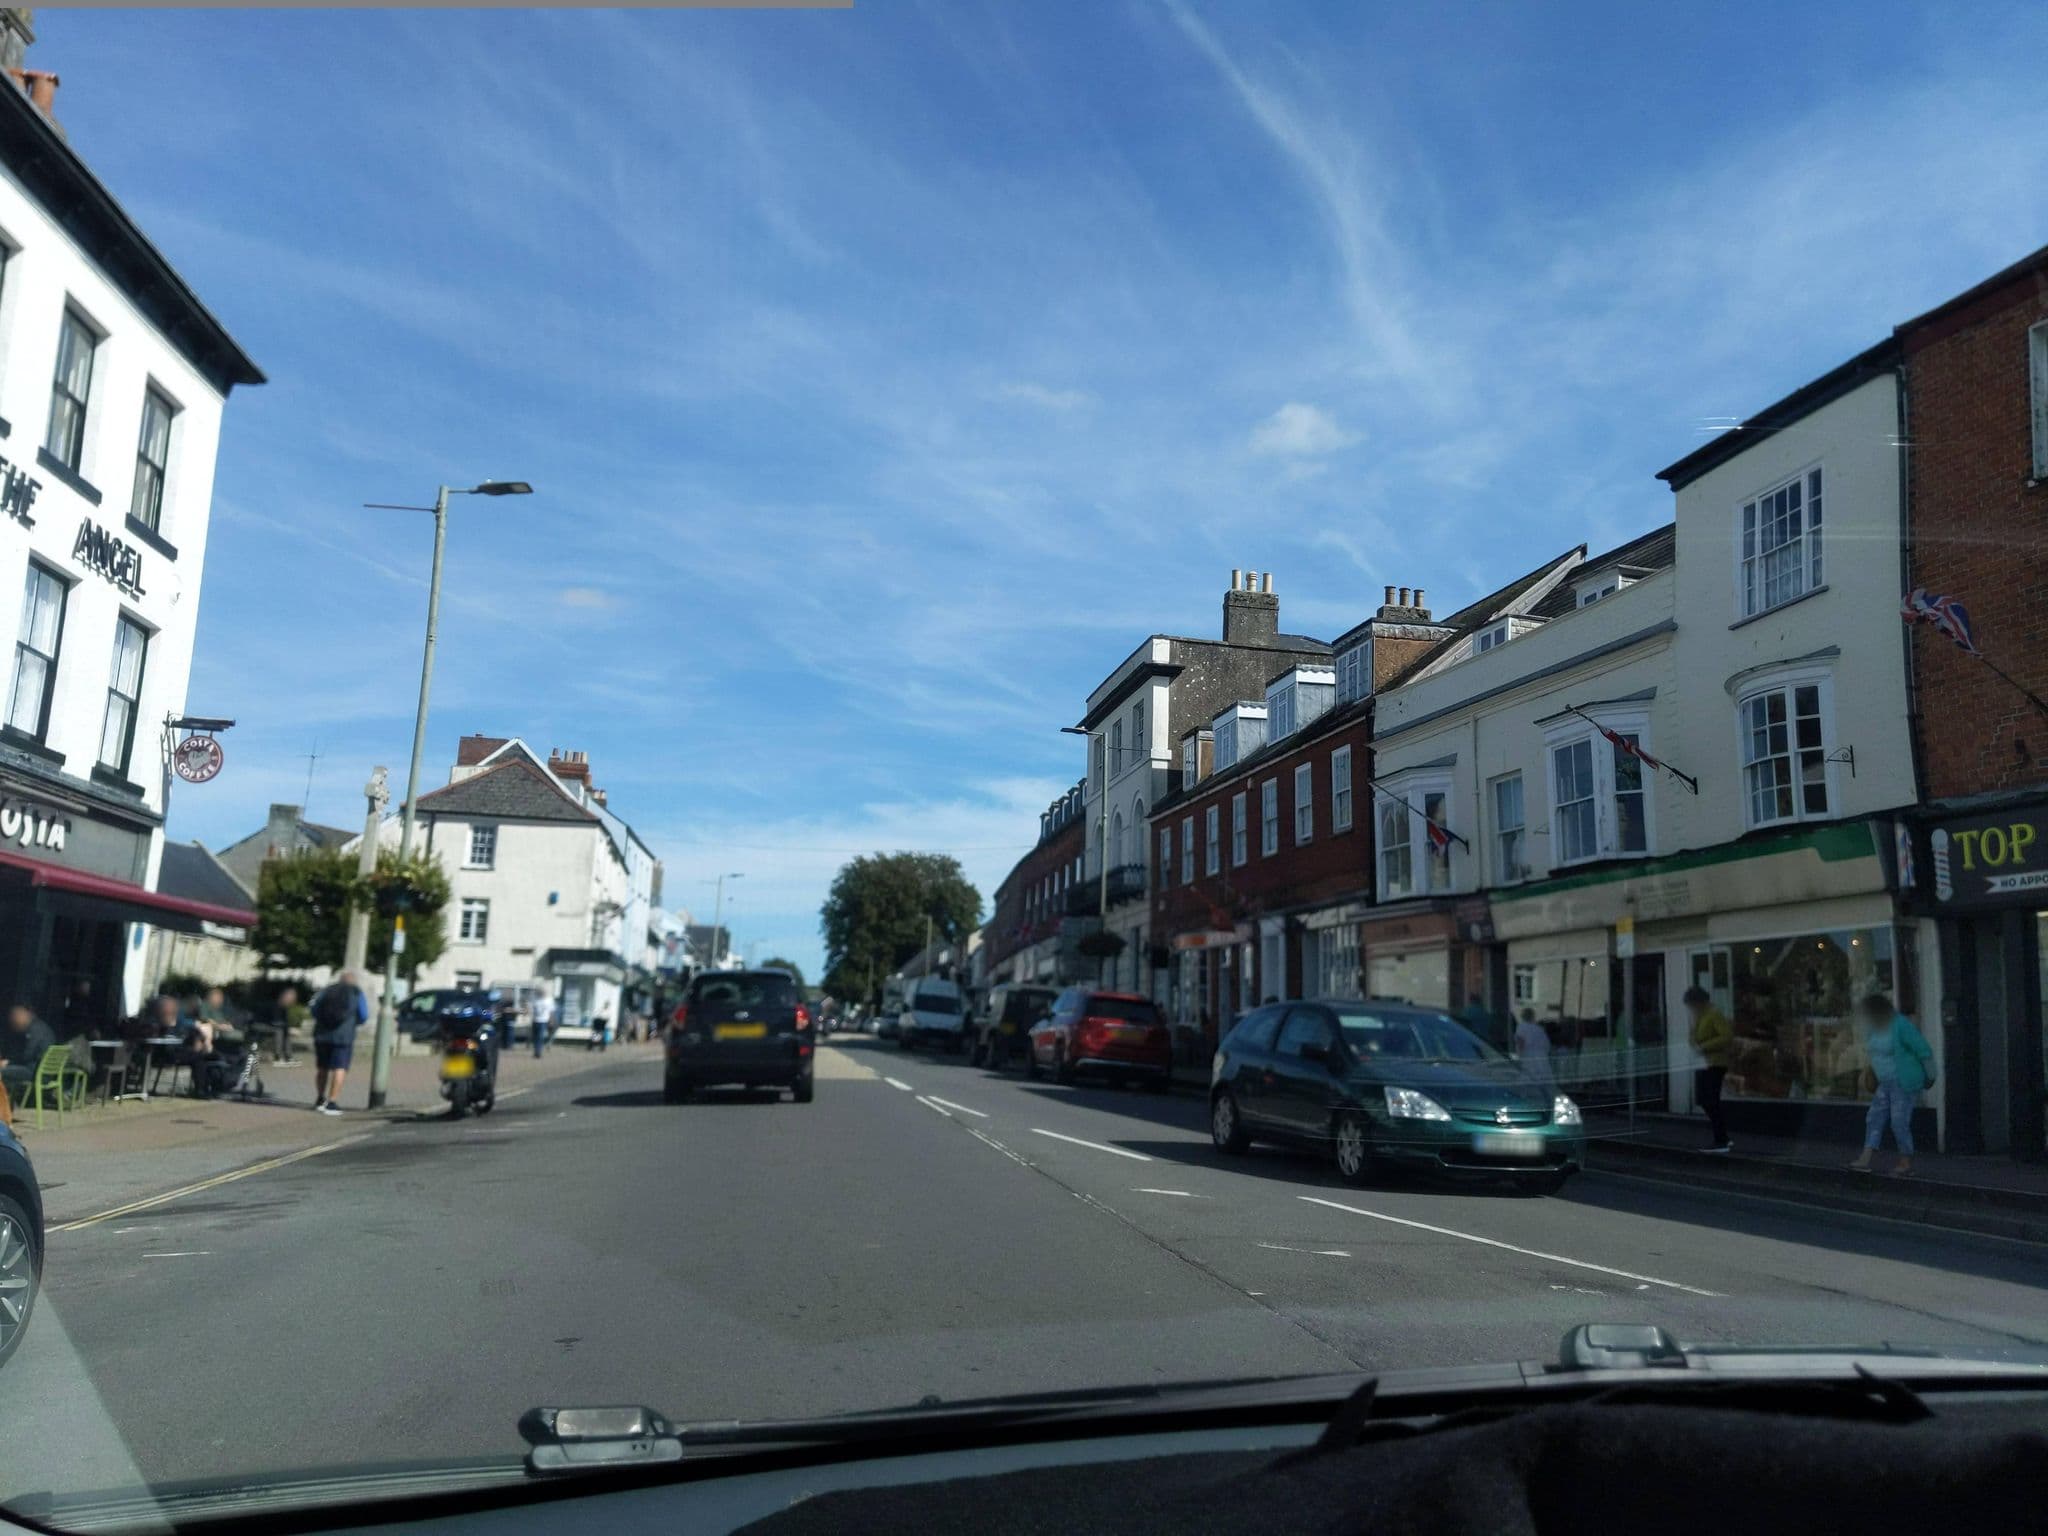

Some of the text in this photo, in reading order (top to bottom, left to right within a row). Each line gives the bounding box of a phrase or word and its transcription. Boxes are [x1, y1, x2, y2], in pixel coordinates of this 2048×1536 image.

[73, 517, 146, 598] ANGEL
[183, 739, 215, 753] COSTA
[179, 762, 215, 780] COFFEE
[1952, 824, 2036, 871] TOP
[2000, 878, 2017, 888] NO
